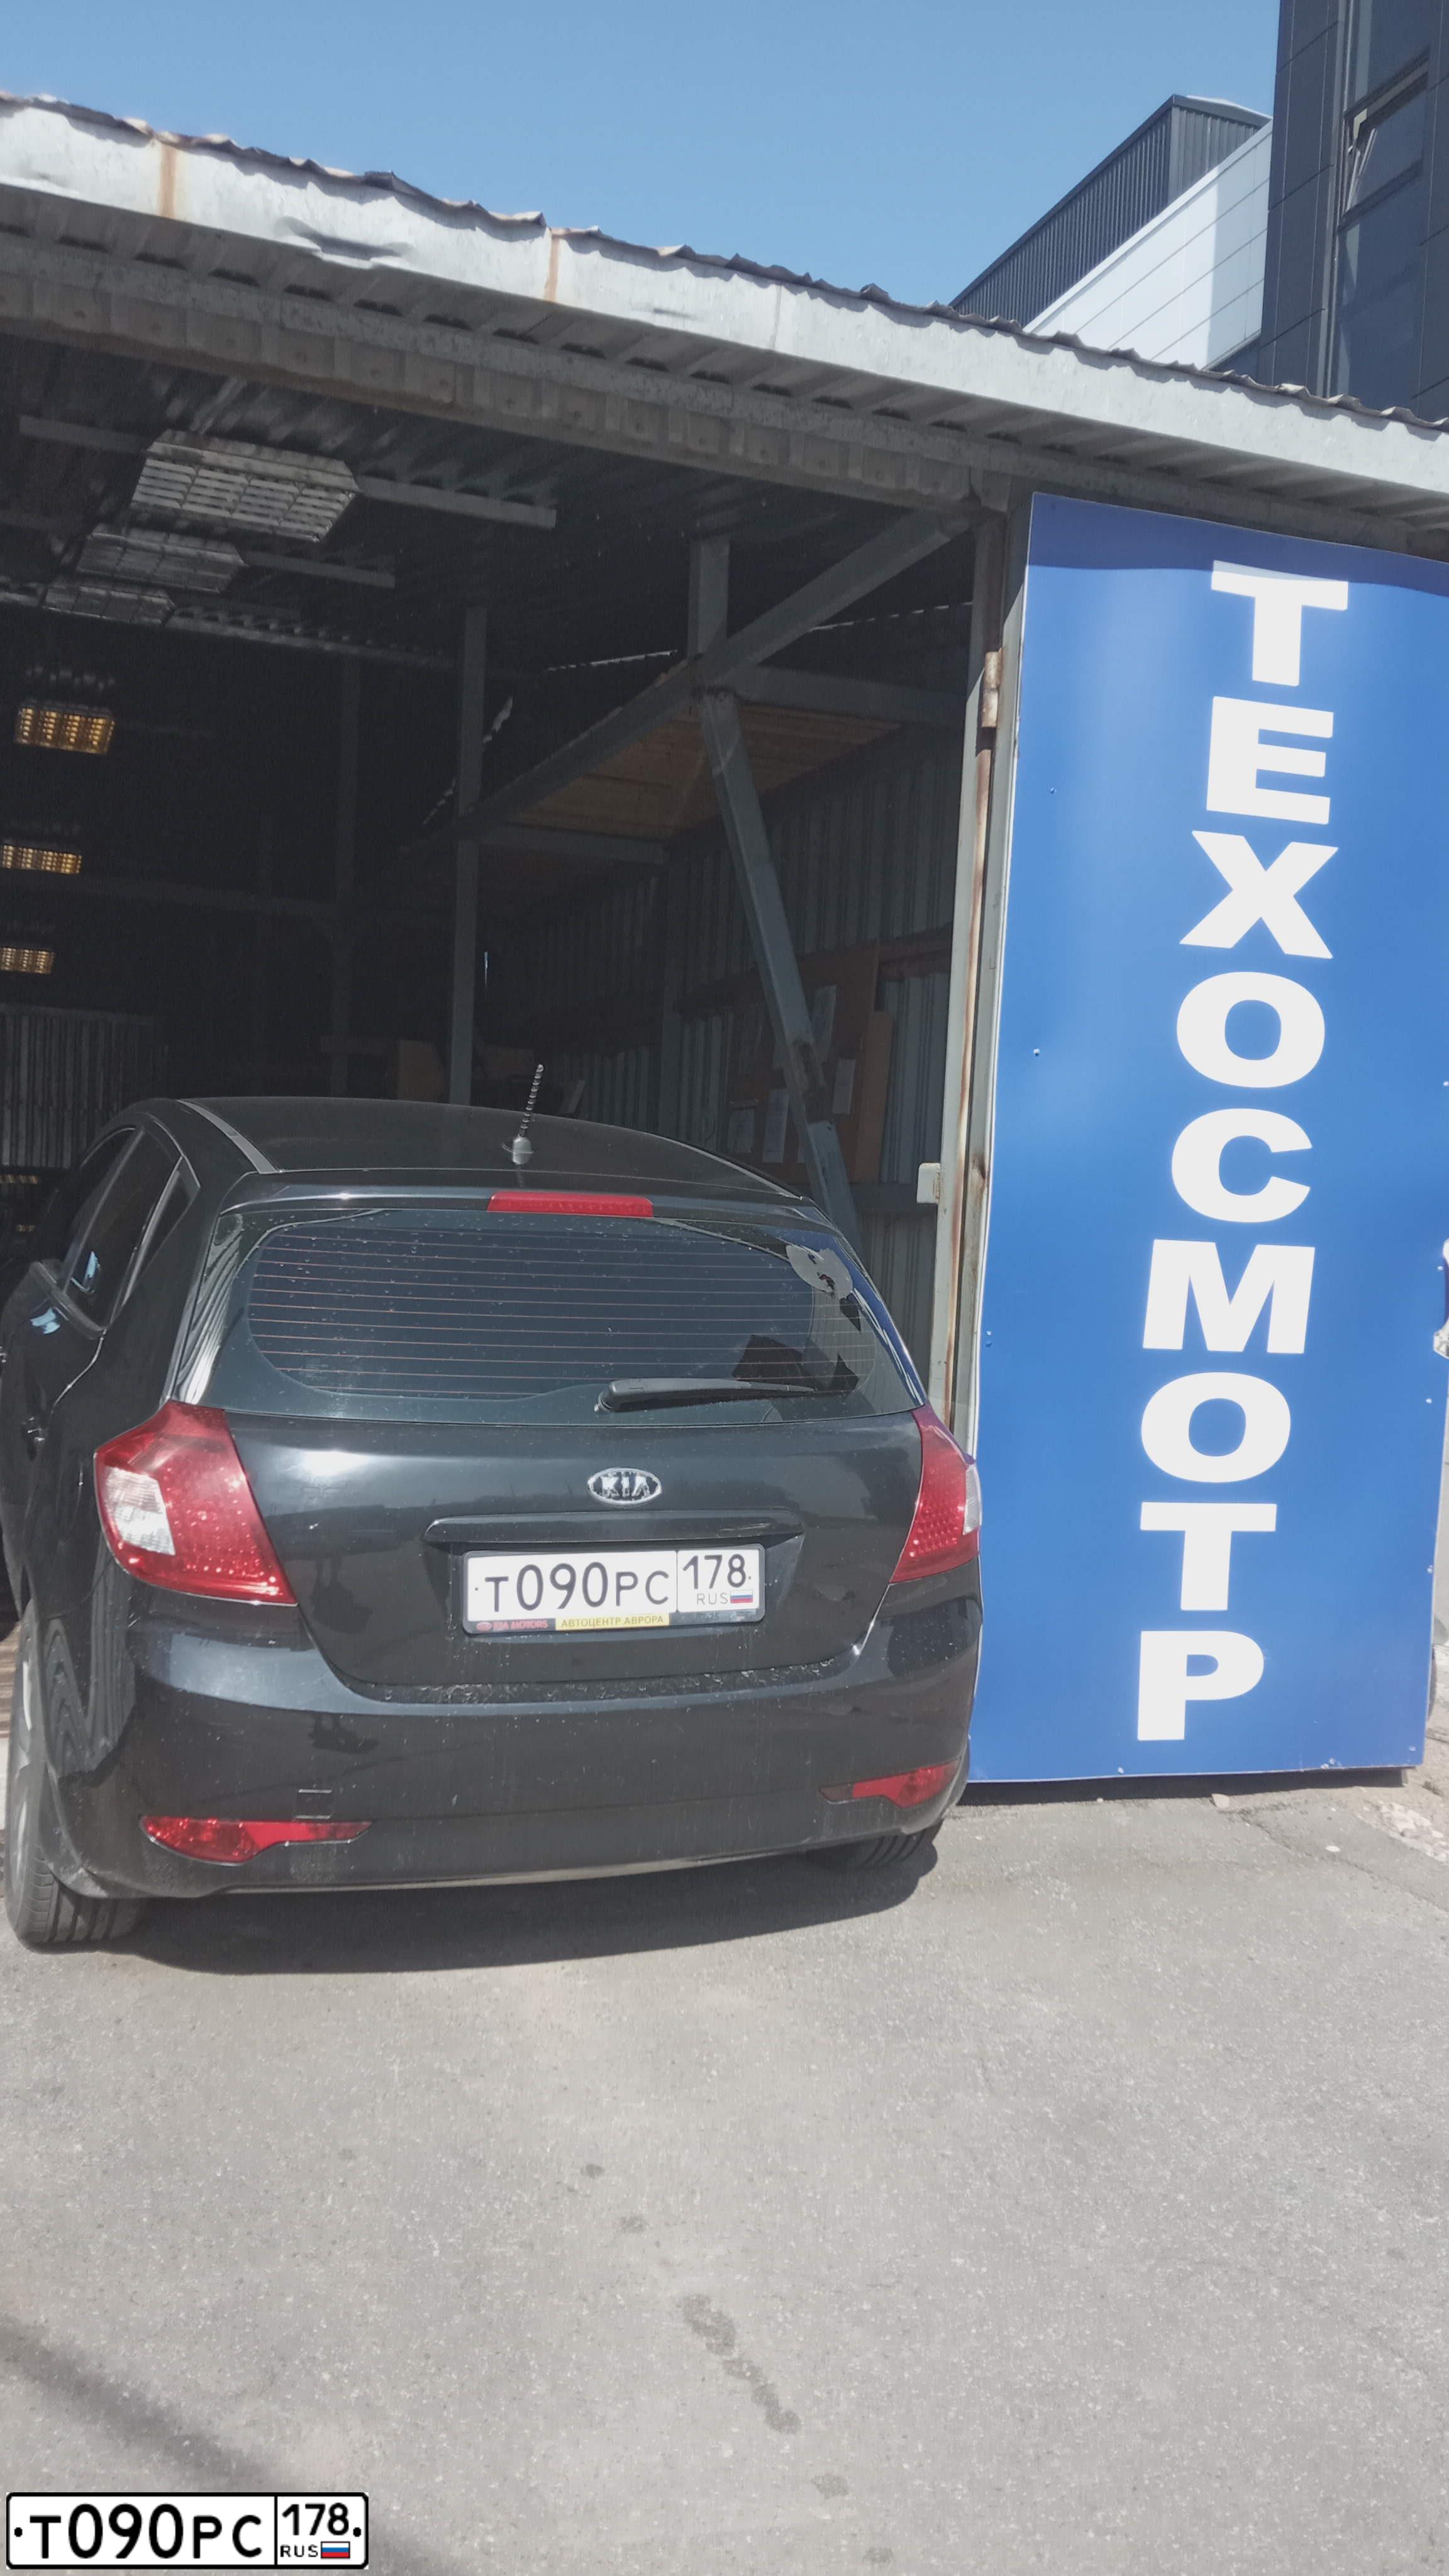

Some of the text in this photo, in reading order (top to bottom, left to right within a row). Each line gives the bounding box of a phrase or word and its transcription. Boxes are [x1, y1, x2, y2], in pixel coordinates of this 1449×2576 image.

[1136, 560, 1350, 1742] ТЕХОСМОТР
[601, 1475, 650, 1497] KIA
[484, 1553, 747, 1612] Т090РС 178
[696, 1589, 728, 1605] RUS
[561, 1615, 663, 1628] АВТОЦЕНТР АВРОРА
